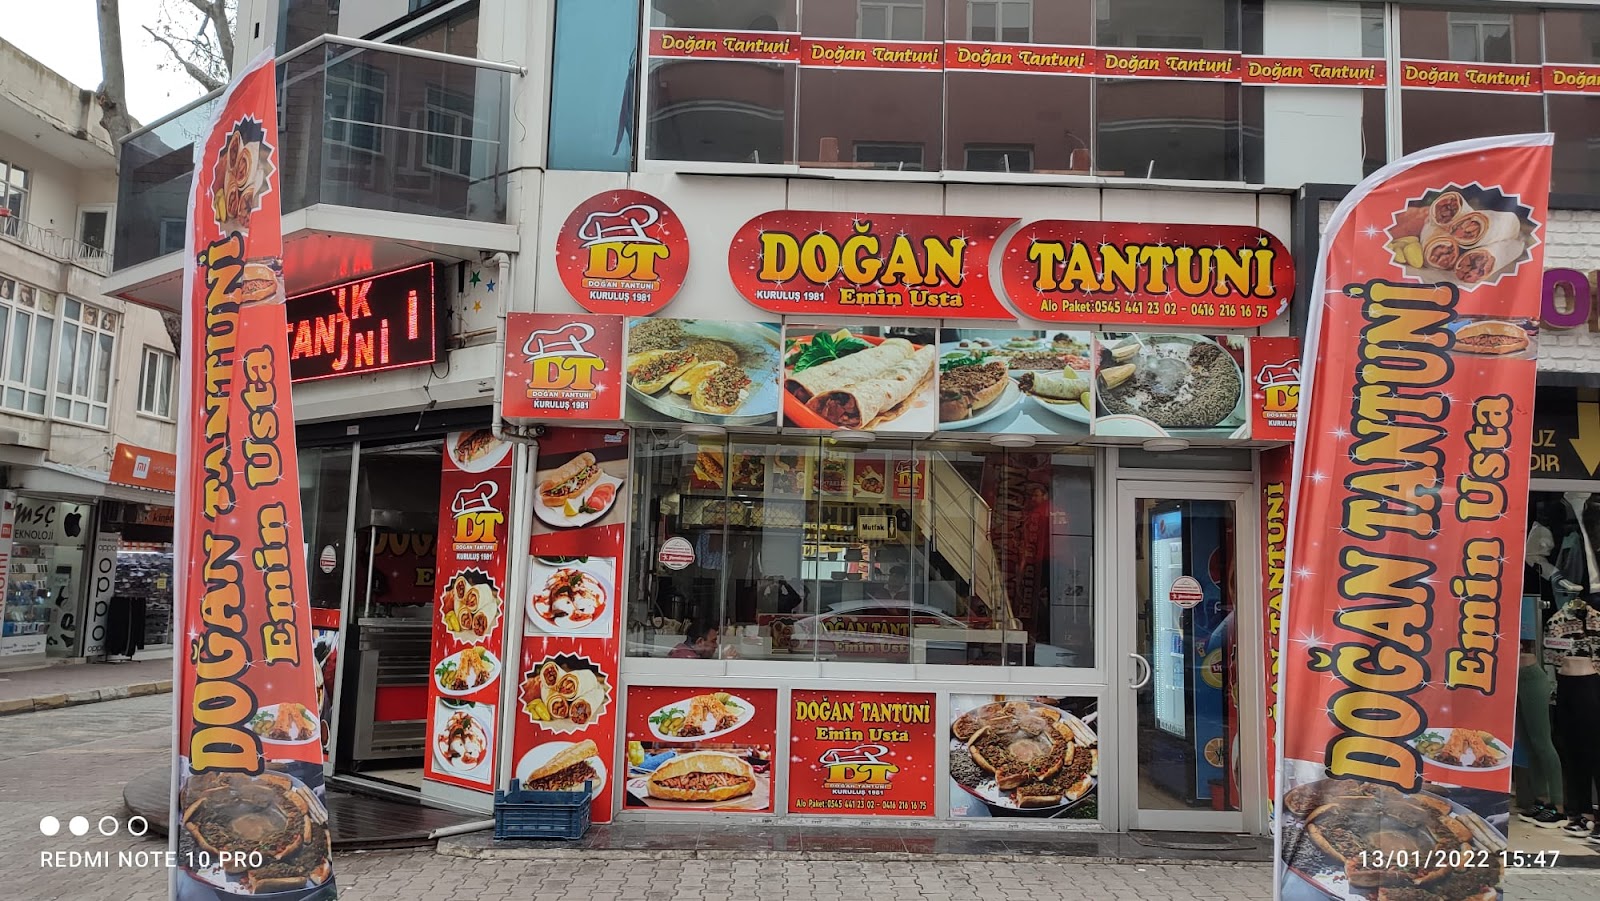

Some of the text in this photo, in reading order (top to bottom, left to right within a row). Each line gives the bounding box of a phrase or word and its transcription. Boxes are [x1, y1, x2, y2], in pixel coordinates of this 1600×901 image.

[660, 34, 790, 54] Doğan Tantuni
[810, 43, 939, 63] Doğan Tantuni
[956, 46, 1085, 68] Doğan Tantuni
[1104, 53, 1232, 73] Doğan Tantuni
[1247, 61, 1376, 79] Doğan Tantuni
[1404, 65, 1531, 86] Doğan Tantuni
[583, 241, 670, 281] DT
[757, 221, 968, 287] DOĞAN
[1027, 236, 1276, 298] TANTUNİ
[589, 290, 651, 303] KURULUŞ 1981
[756, 290, 824, 302] KURULUŞ 1981
[839, 288, 963, 307] Emin Usta
[1040, 300, 1058, 312] Alo
[1062, 300, 1121, 314] Paket:0545
[1124, 301, 1143, 314] 441
[1147, 302, 1160, 314] 23
[1164, 303, 1177, 315] 02
[1191, 303, 1215, 316] 0416
[1219, 304, 1236, 317] 216
[1240, 305, 1252, 317] 16
[1255, 305, 1268, 318] 75
[526, 356, 606, 391] DT
[533, 400, 590, 411] KURULUŞ 1981
[241, 344, 300, 667] Emin Usta
[14, 529, 54, 540] EKNOLOJİ
[453, 512, 504, 543] DT
[1307, 278, 1460, 795] DOĞAN TANTUNİ
[1445, 393, 1514, 697] Emin Usta
[189, 529, 265, 776] DOĞAN
[795, 697, 931, 723] DOĞAN TANTUNİ
[816, 727, 910, 742] Emin Usta
[826, 765, 900, 784] DT
[796, 798, 806, 808] Alo
[857, 800, 864, 809] 23
[867, 800, 875, 809] 02
[899, 801, 908, 810] 216
[911, 802, 917, 810] 16
[919, 802, 927, 810] 75
